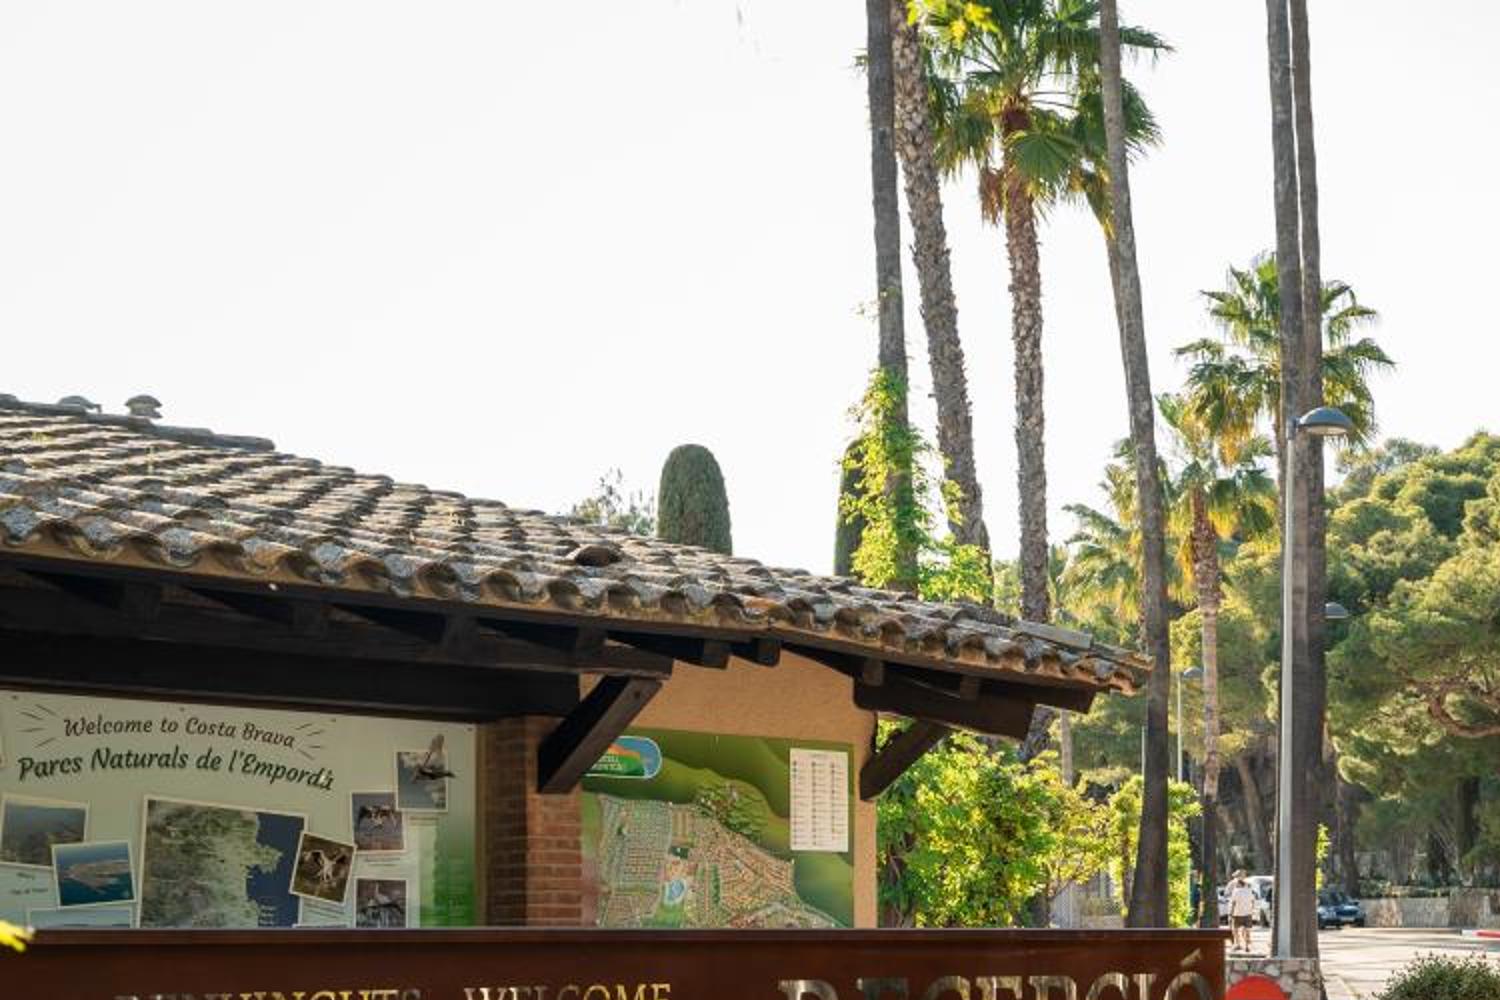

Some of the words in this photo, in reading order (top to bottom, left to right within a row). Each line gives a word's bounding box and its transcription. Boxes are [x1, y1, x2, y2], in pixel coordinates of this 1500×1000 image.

[64, 714, 153, 737] Welcome
[160, 717, 179, 734] to
[185, 717, 237, 739] Costa
[242, 722, 296, 748] Brava
[17, 756, 83, 782] Parcs
[91, 745, 189, 772] Naturals
[195, 746, 222, 771] de
